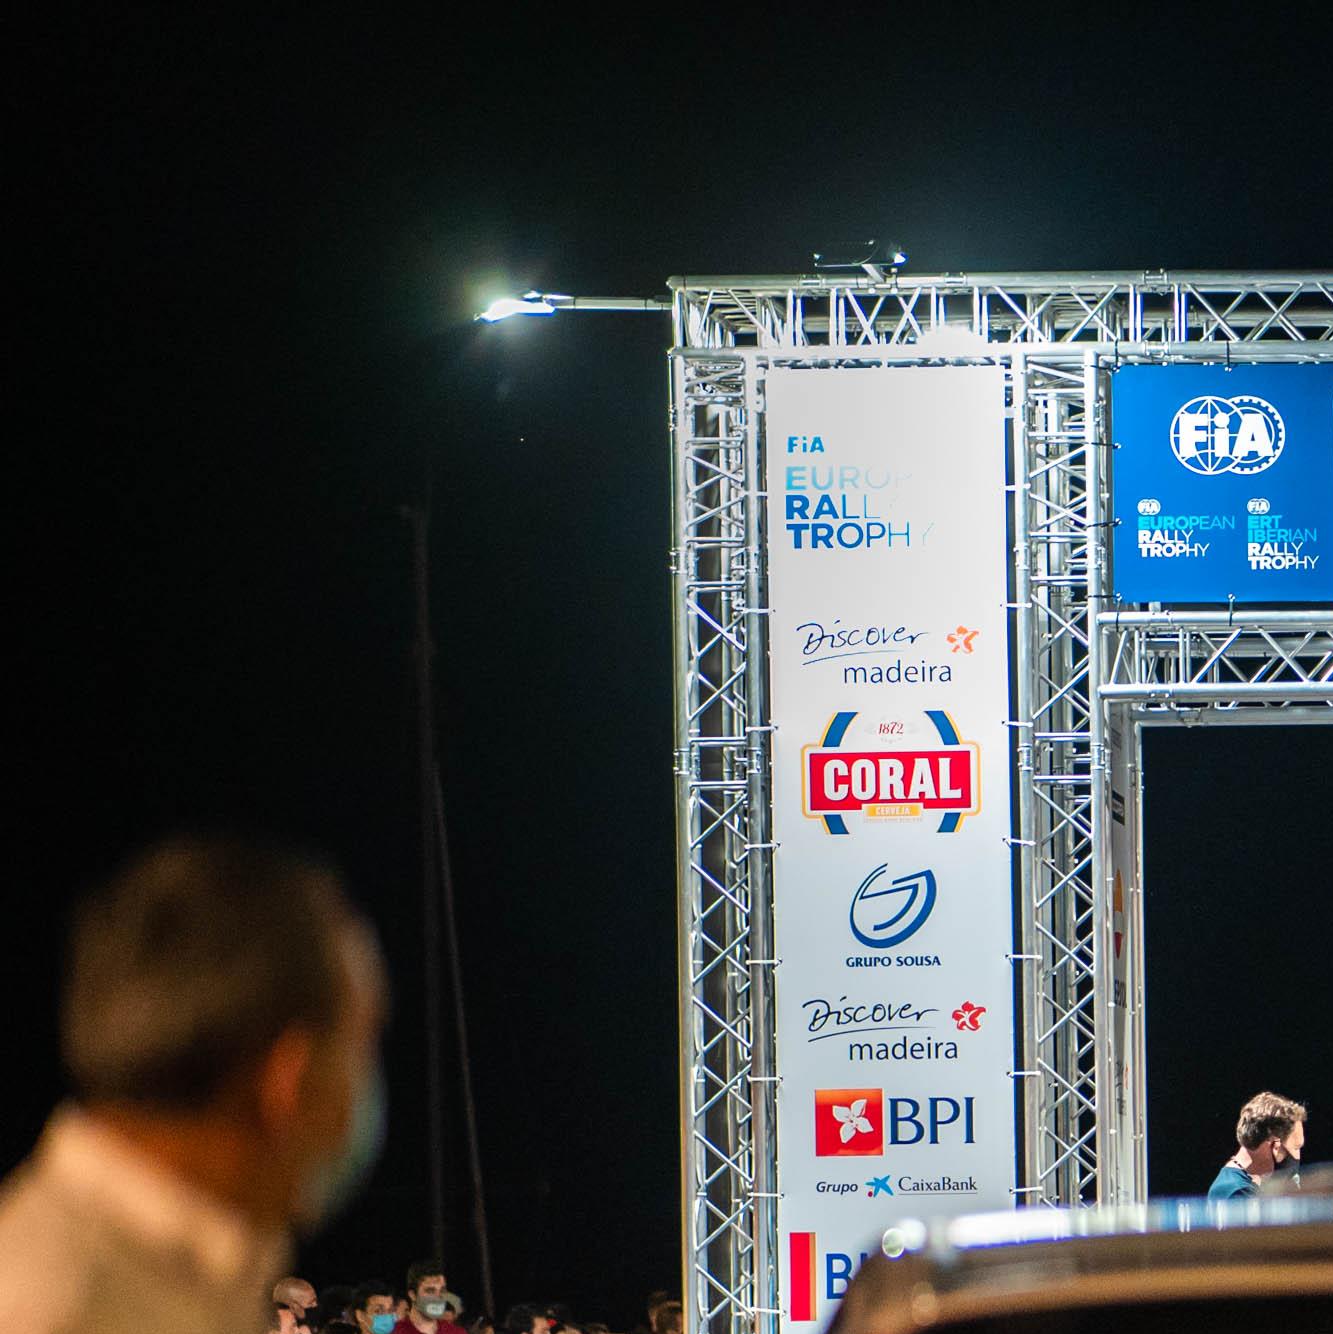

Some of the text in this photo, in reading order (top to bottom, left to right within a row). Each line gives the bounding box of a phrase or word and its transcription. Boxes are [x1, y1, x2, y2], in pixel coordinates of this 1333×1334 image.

[785, 465, 912, 491] EUROP
[785, 494, 883, 520] RALL
[1138, 515, 1235, 531] EUROPEAN
[1248, 515, 1282, 529] ERT
[1138, 530, 1194, 544] RALLY
[1248, 528, 1317, 542] IBERIAN
[1138, 543, 1210, 558] TROPHY
[1248, 542, 1303, 556] RALLY
[1248, 555, 1319, 570] TROPHY
[796, 620, 928, 657] Discover
[843, 660, 953, 683] madeira
[823, 757, 962, 800] CORAL
[846, 955, 941, 967] GRUPO SOUSA
[802, 996, 939, 1032] Discover
[849, 1037, 958, 1060] madeira
[889, 1096, 976, 1145] BPI
[816, 1176, 978, 1194] Grupo CaixaBank
